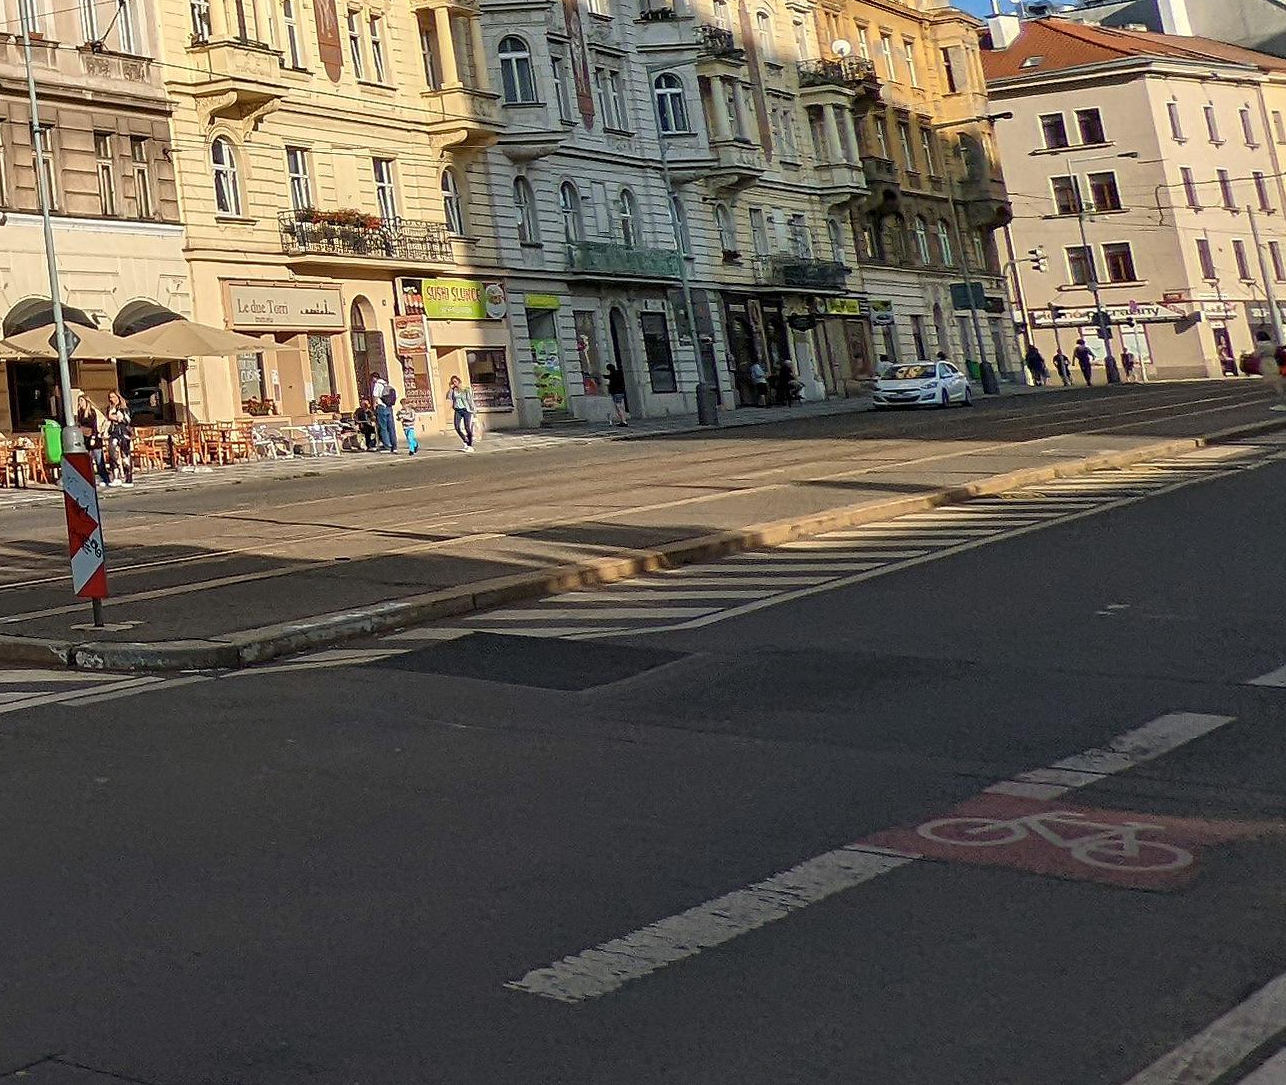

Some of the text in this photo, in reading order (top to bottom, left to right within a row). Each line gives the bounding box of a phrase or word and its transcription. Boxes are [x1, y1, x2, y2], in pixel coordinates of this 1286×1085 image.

[426, 286, 481, 303] SUSHI SLUNCE
[237, 298, 289, 315] Le due Torri
